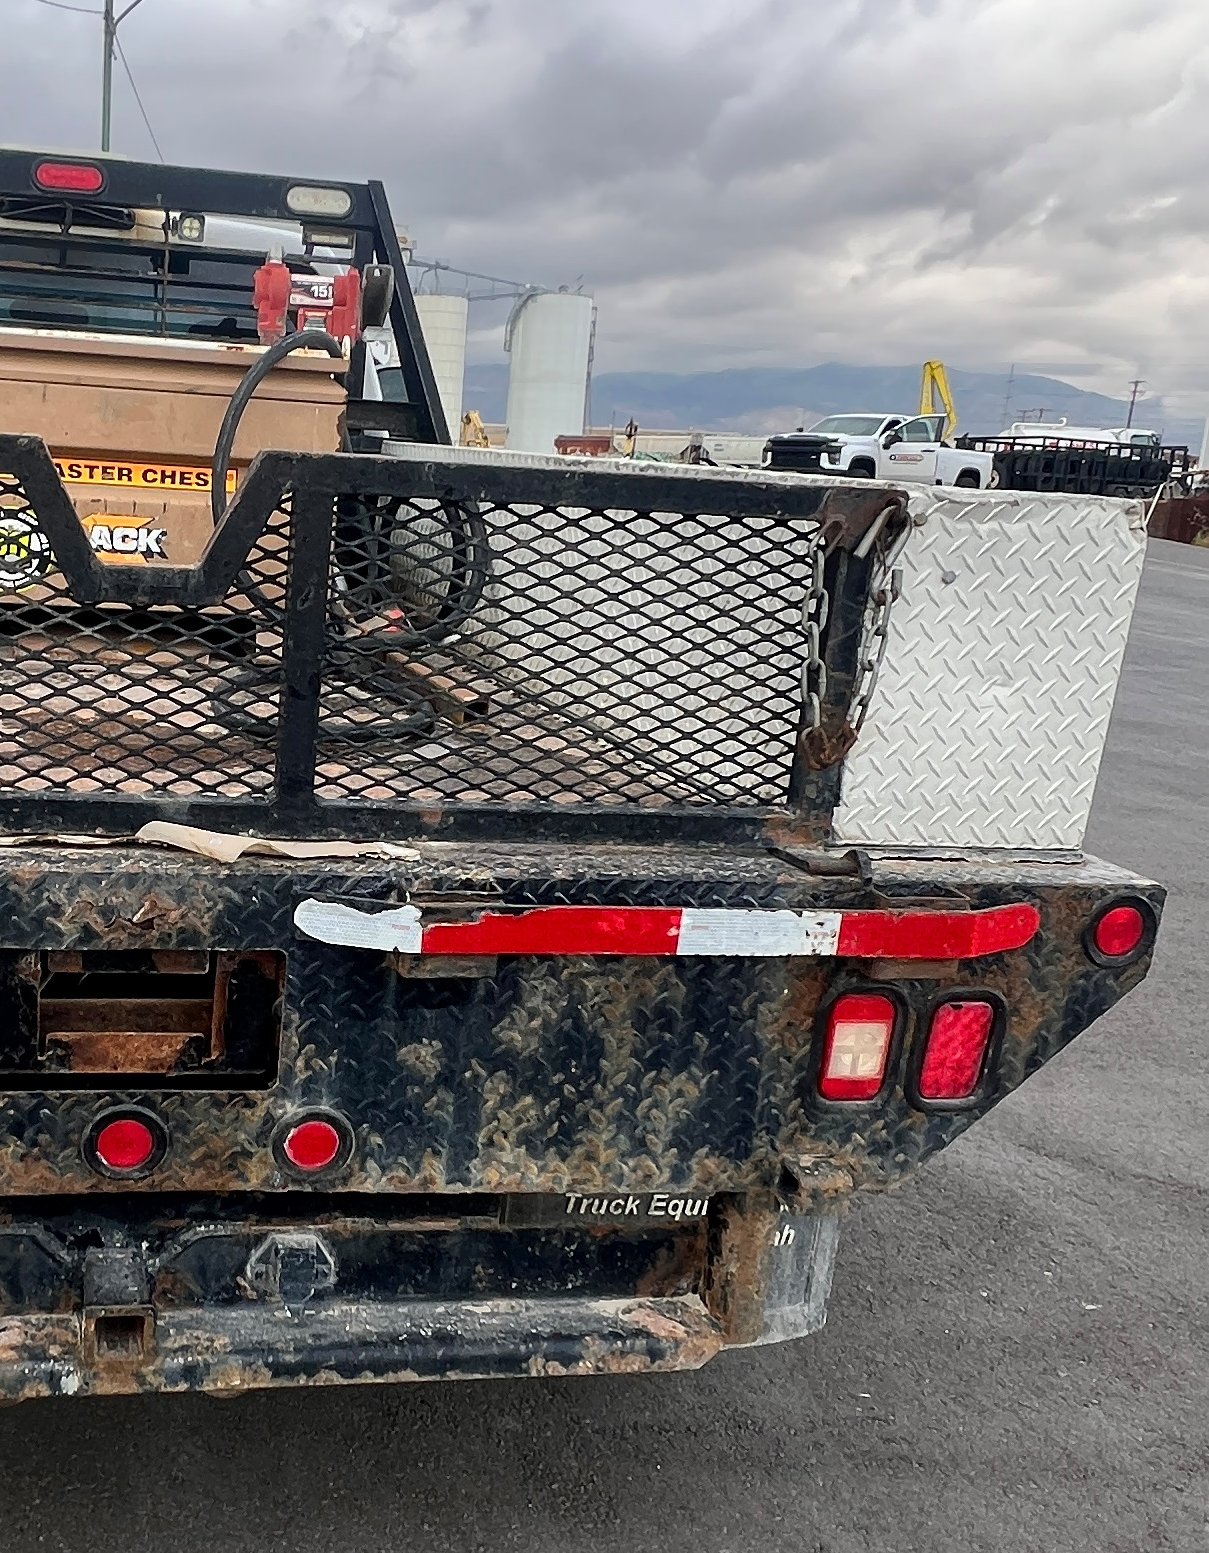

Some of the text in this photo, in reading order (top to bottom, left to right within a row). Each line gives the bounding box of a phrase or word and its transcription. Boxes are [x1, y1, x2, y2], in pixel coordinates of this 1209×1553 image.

[54, 462, 211, 487] ASTER CHES
[91, 524, 165, 555] ACK
[565, 1193, 709, 1221] Truck Equi
